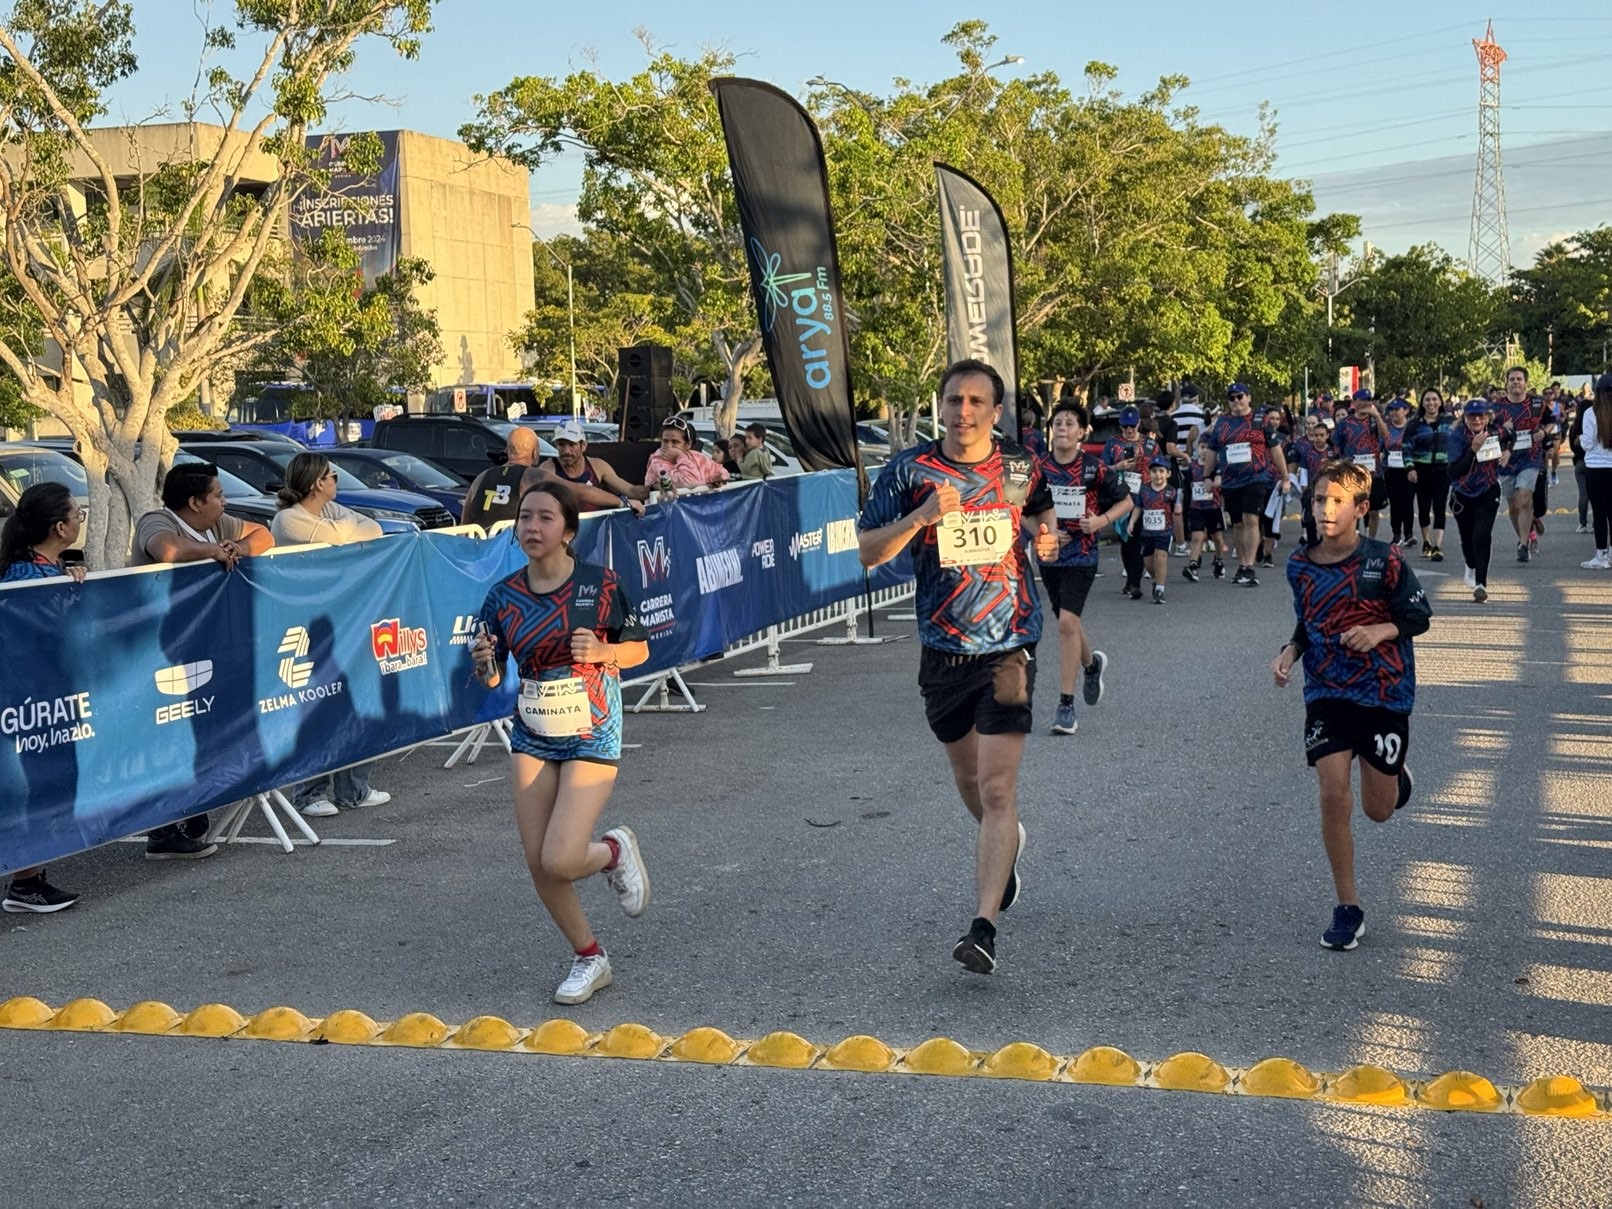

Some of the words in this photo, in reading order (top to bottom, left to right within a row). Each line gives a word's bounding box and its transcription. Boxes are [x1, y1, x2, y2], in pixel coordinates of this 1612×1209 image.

[300, 207, 394, 228] ABIERTAS!
[822, 293, 834, 321] 88.5
[751, 538, 775, 558] POWER
[953, 525, 997, 548] 310
[640, 593, 673, 613] CARRERA
[640, 608, 675, 627] MARISTA
[371, 618, 427, 659] Willys
[155, 695, 215, 725] GEELY
[258, 693, 298, 714] ZELMA
[298, 681, 343, 704] KOOLER
[525, 704, 582, 716] CAMINATA
[0, 692, 93, 735] GÚRATE
[16, 733, 49, 754] hoy,
[51, 722, 96, 746] hazlo.
[1374, 732, 1402, 765] 10
